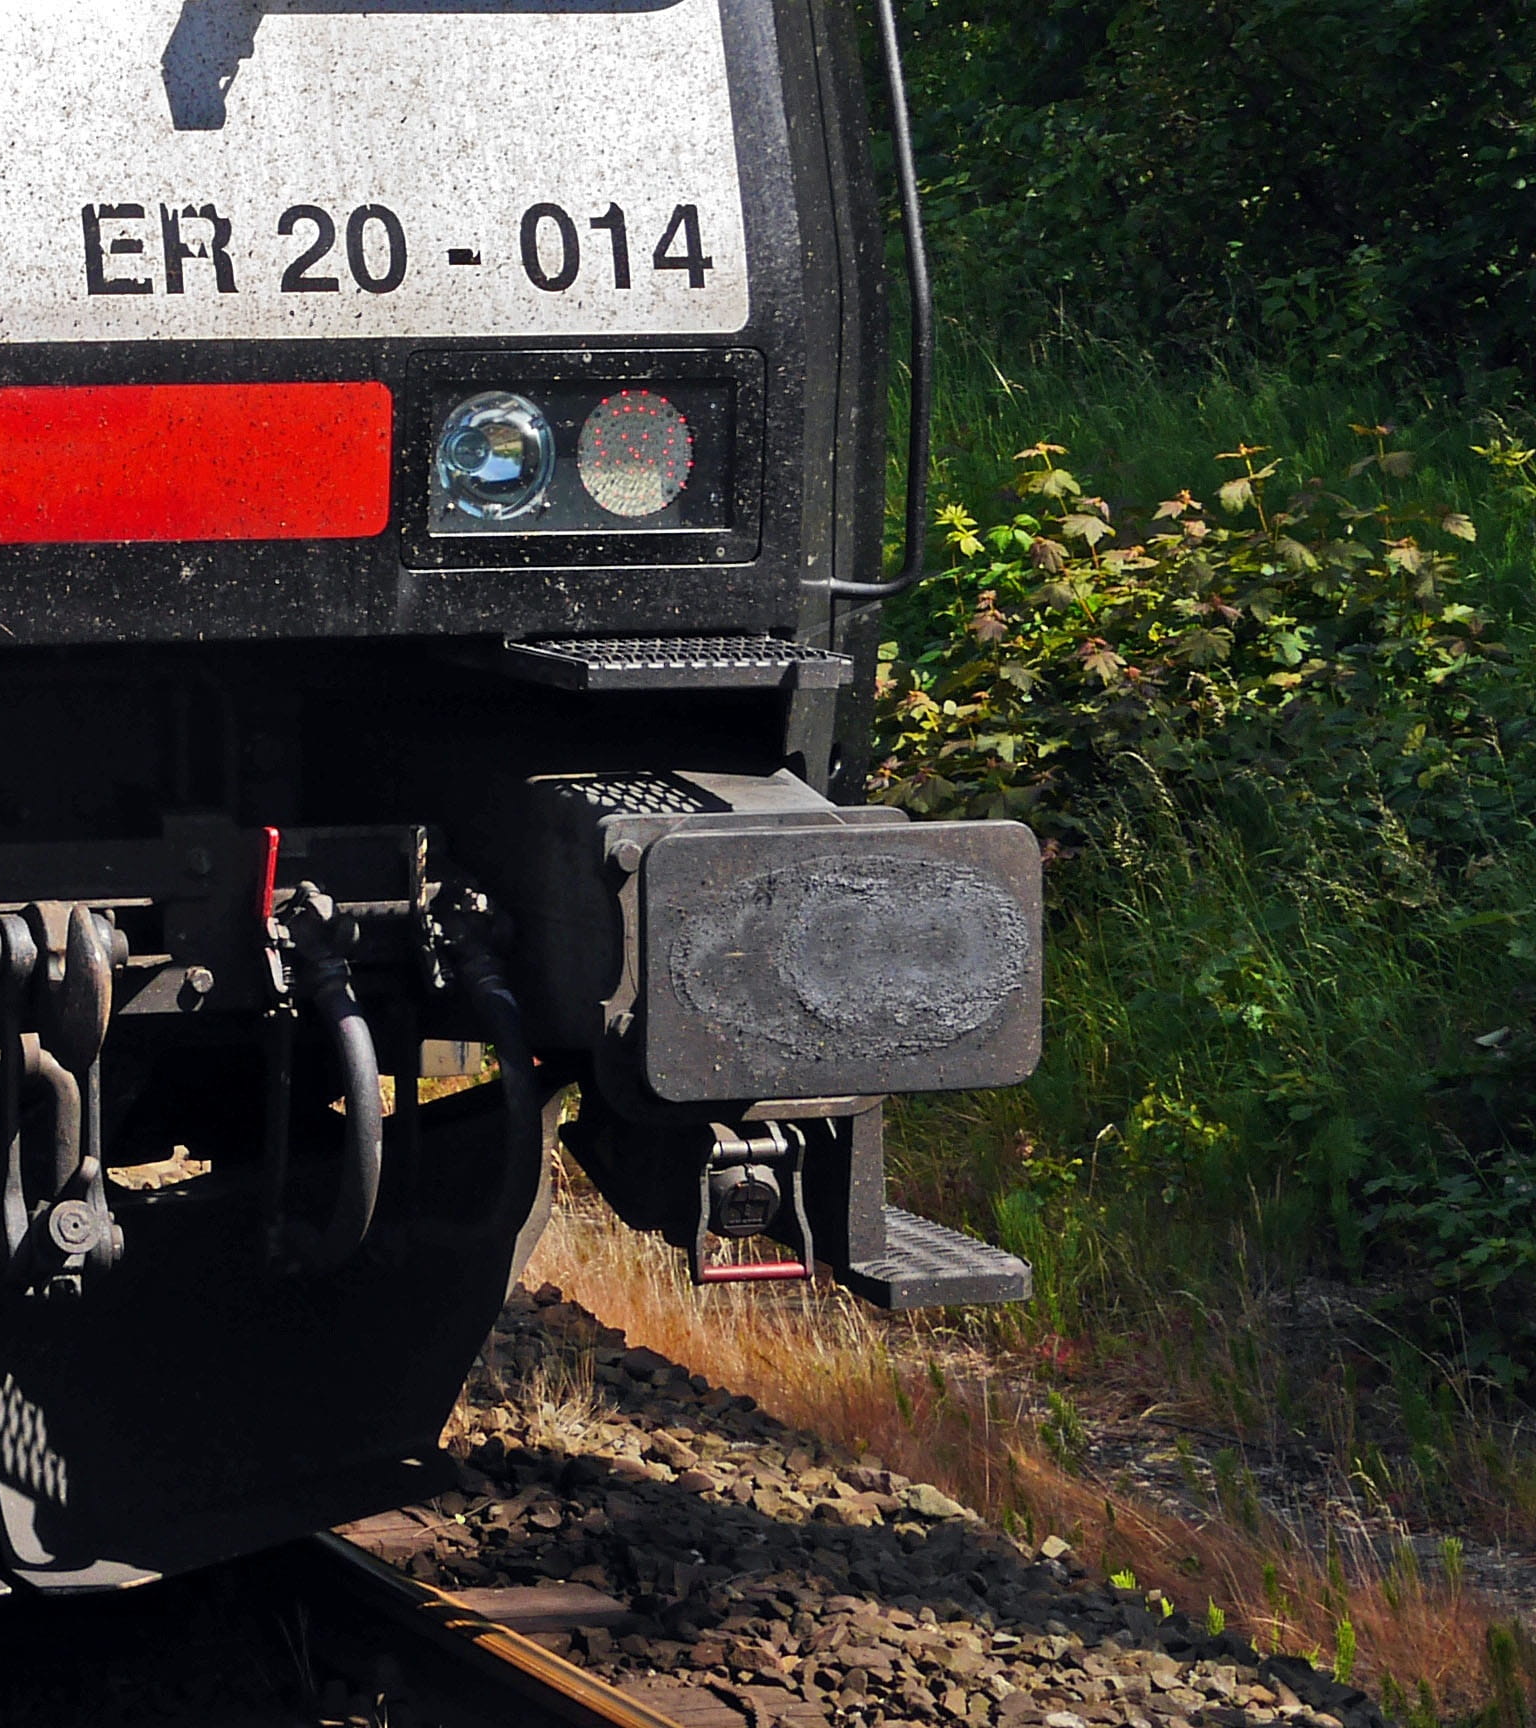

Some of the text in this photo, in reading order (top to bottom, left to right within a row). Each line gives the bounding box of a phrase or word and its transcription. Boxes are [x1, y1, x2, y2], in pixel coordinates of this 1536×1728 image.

[81, 202, 239, 295] ER
[277, 203, 409, 294] 20
[520, 201, 714, 293] 014
